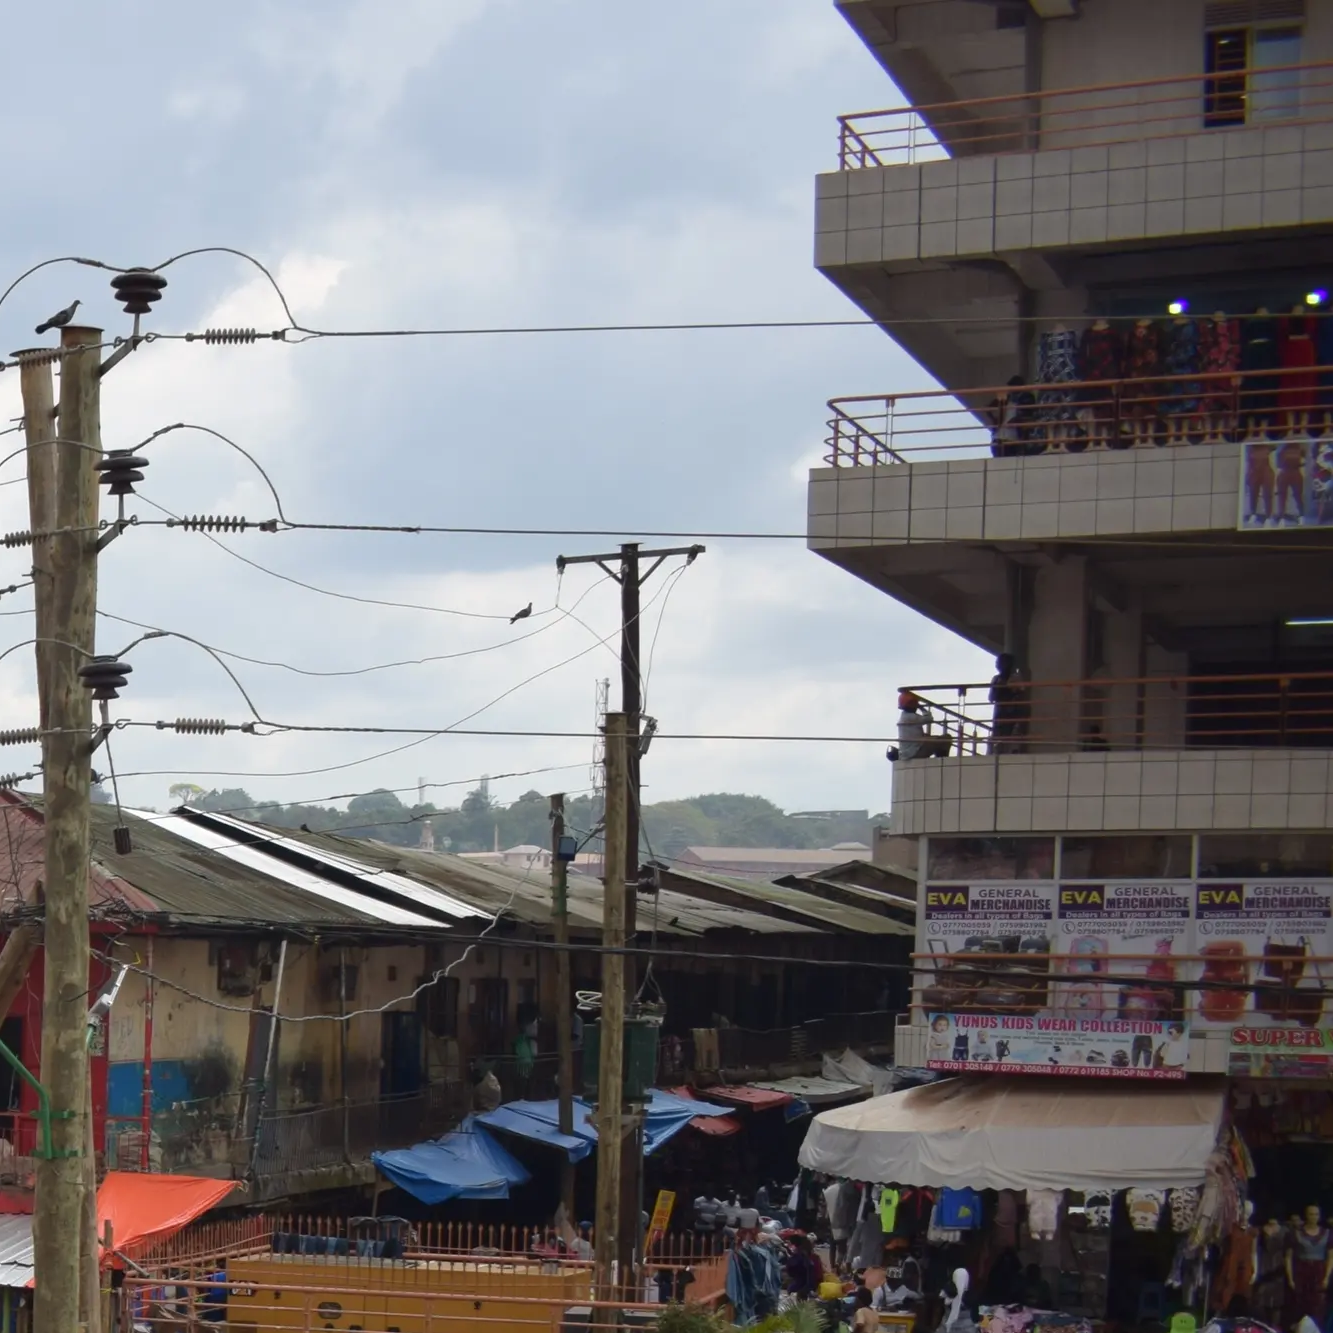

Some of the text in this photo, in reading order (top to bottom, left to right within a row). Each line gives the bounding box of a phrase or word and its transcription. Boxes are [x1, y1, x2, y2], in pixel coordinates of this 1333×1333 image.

[979, 889, 1039, 898] GENERAL
[1061, 891, 1102, 904] EVA
[1115, 887, 1177, 896] GENERAL
[1199, 891, 1240, 904] EVA
[1254, 887, 1318, 896] GENERAL
[927, 892, 966, 905] EVA
[970, 899, 1051, 910] MERCHANDISE
[1106, 897, 1189, 909] MERCHANDISE
[1244, 896, 1331, 908] MERCHANDISE
[954, 1015, 997, 1028] YUNUS
[1001, 1016, 1033, 1030] KIDS
[1038, 1017, 1076, 1031] WEAR
[1081, 1019, 1162, 1034] COLLECTION
[1231, 1027, 1324, 1048] SUPER
[966, 1063, 993, 1071] 305148
